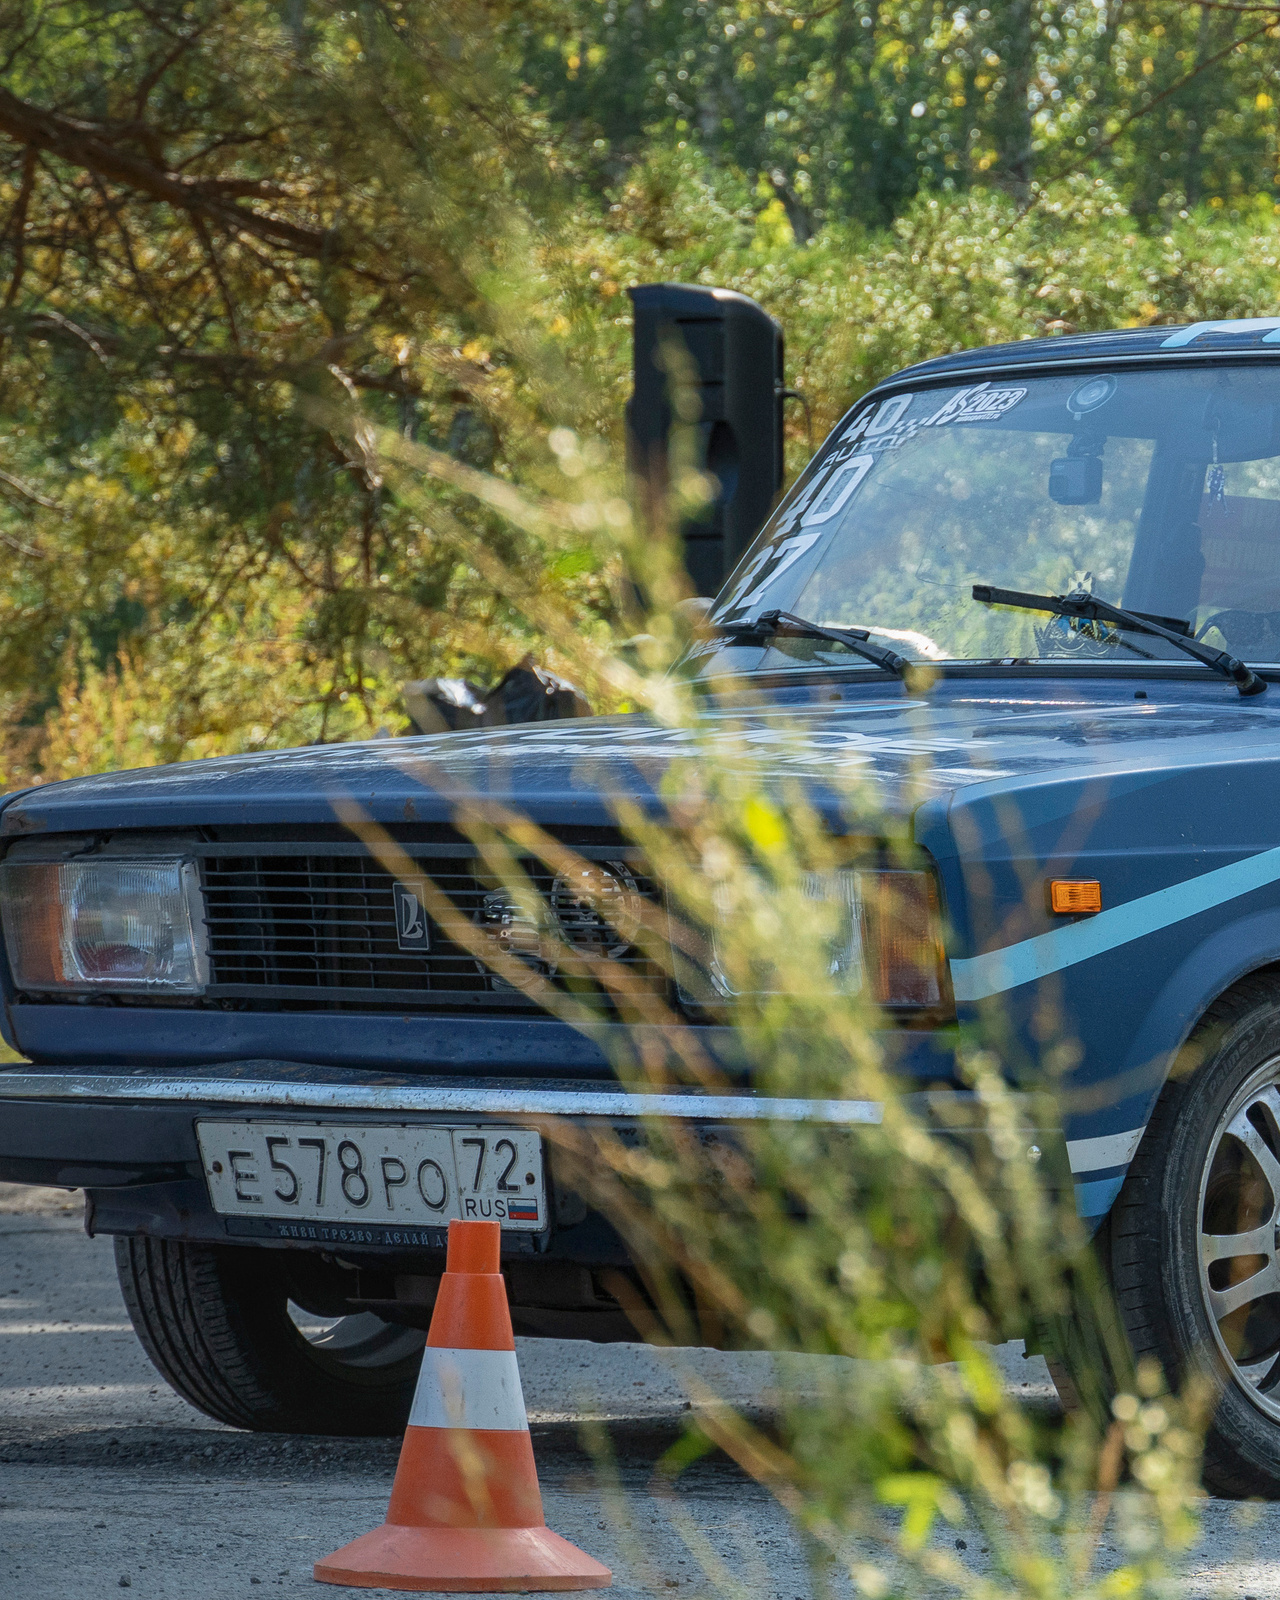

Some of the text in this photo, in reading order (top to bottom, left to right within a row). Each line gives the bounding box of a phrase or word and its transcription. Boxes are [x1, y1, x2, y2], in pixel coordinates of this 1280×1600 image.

[838, 393, 913, 443] 40
[961, 390, 1024, 413] 2023
[771, 454, 874, 540] 40
[709, 532, 822, 626] 37
[465, 1198, 507, 1219] RUS
[385, 1231, 429, 1247] ДЕЛАЙ
